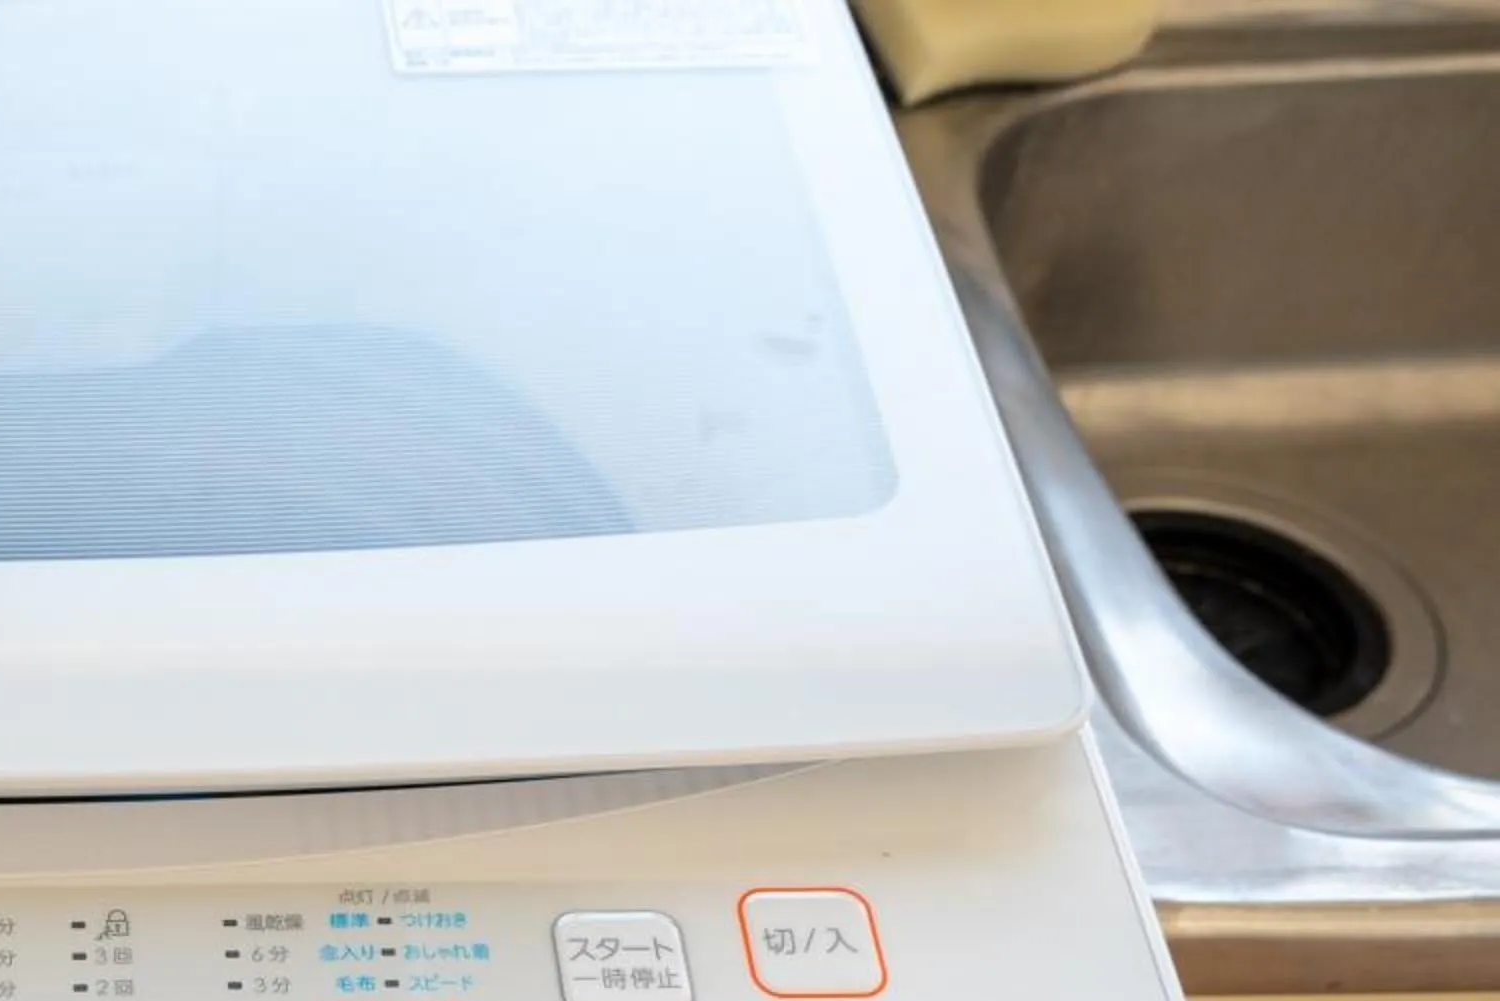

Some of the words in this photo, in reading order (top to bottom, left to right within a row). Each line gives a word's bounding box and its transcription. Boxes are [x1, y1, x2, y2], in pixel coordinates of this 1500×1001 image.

[567, 936, 675, 961] スタート
[336, 976, 376, 992] 毛布
[408, 974, 474, 992] スピード
[573, 968, 680, 991] 一時停止
